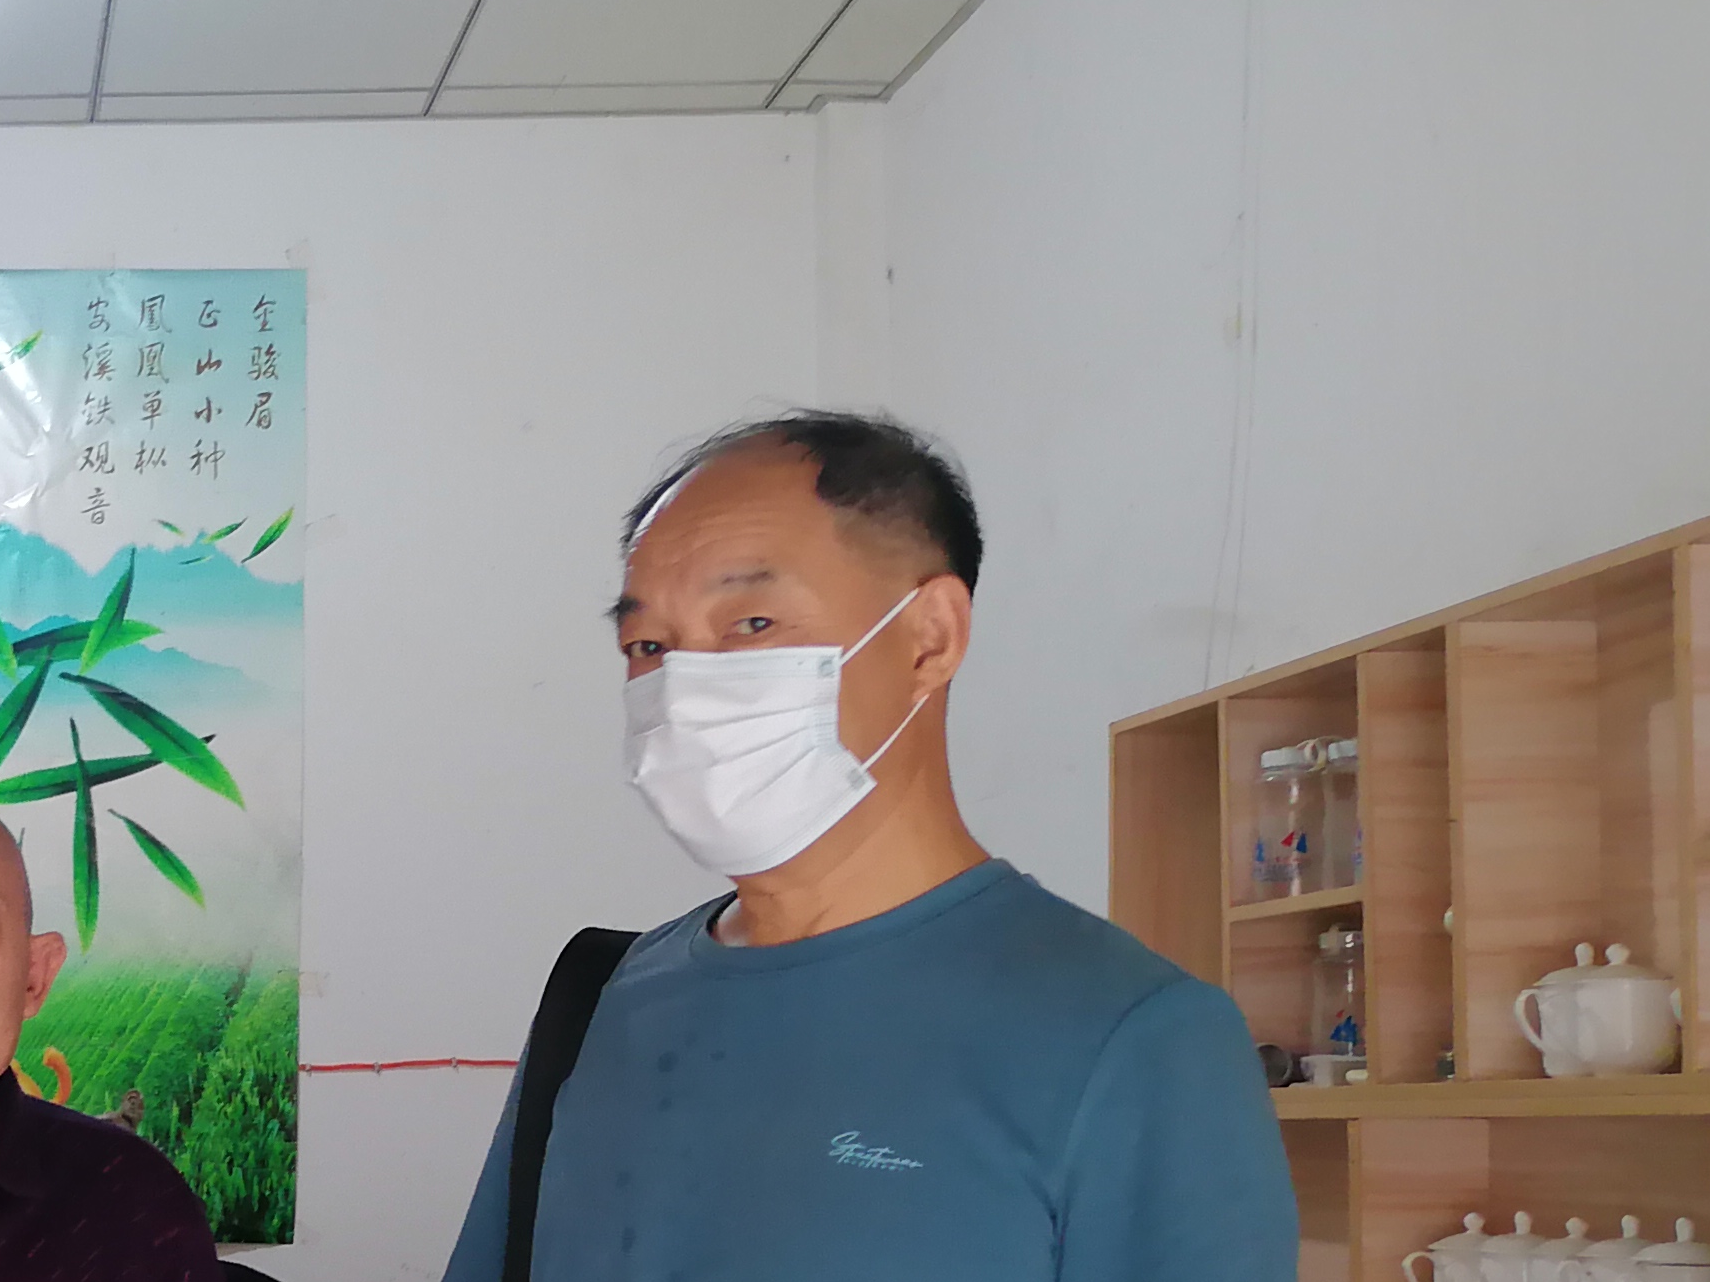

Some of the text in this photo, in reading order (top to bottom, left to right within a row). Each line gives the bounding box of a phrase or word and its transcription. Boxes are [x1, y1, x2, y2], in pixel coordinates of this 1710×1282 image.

[79, 297, 115, 525] 安溪铁观音
[190, 300, 226, 480] 正山小种
[246, 294, 281, 430] 金骏眉
